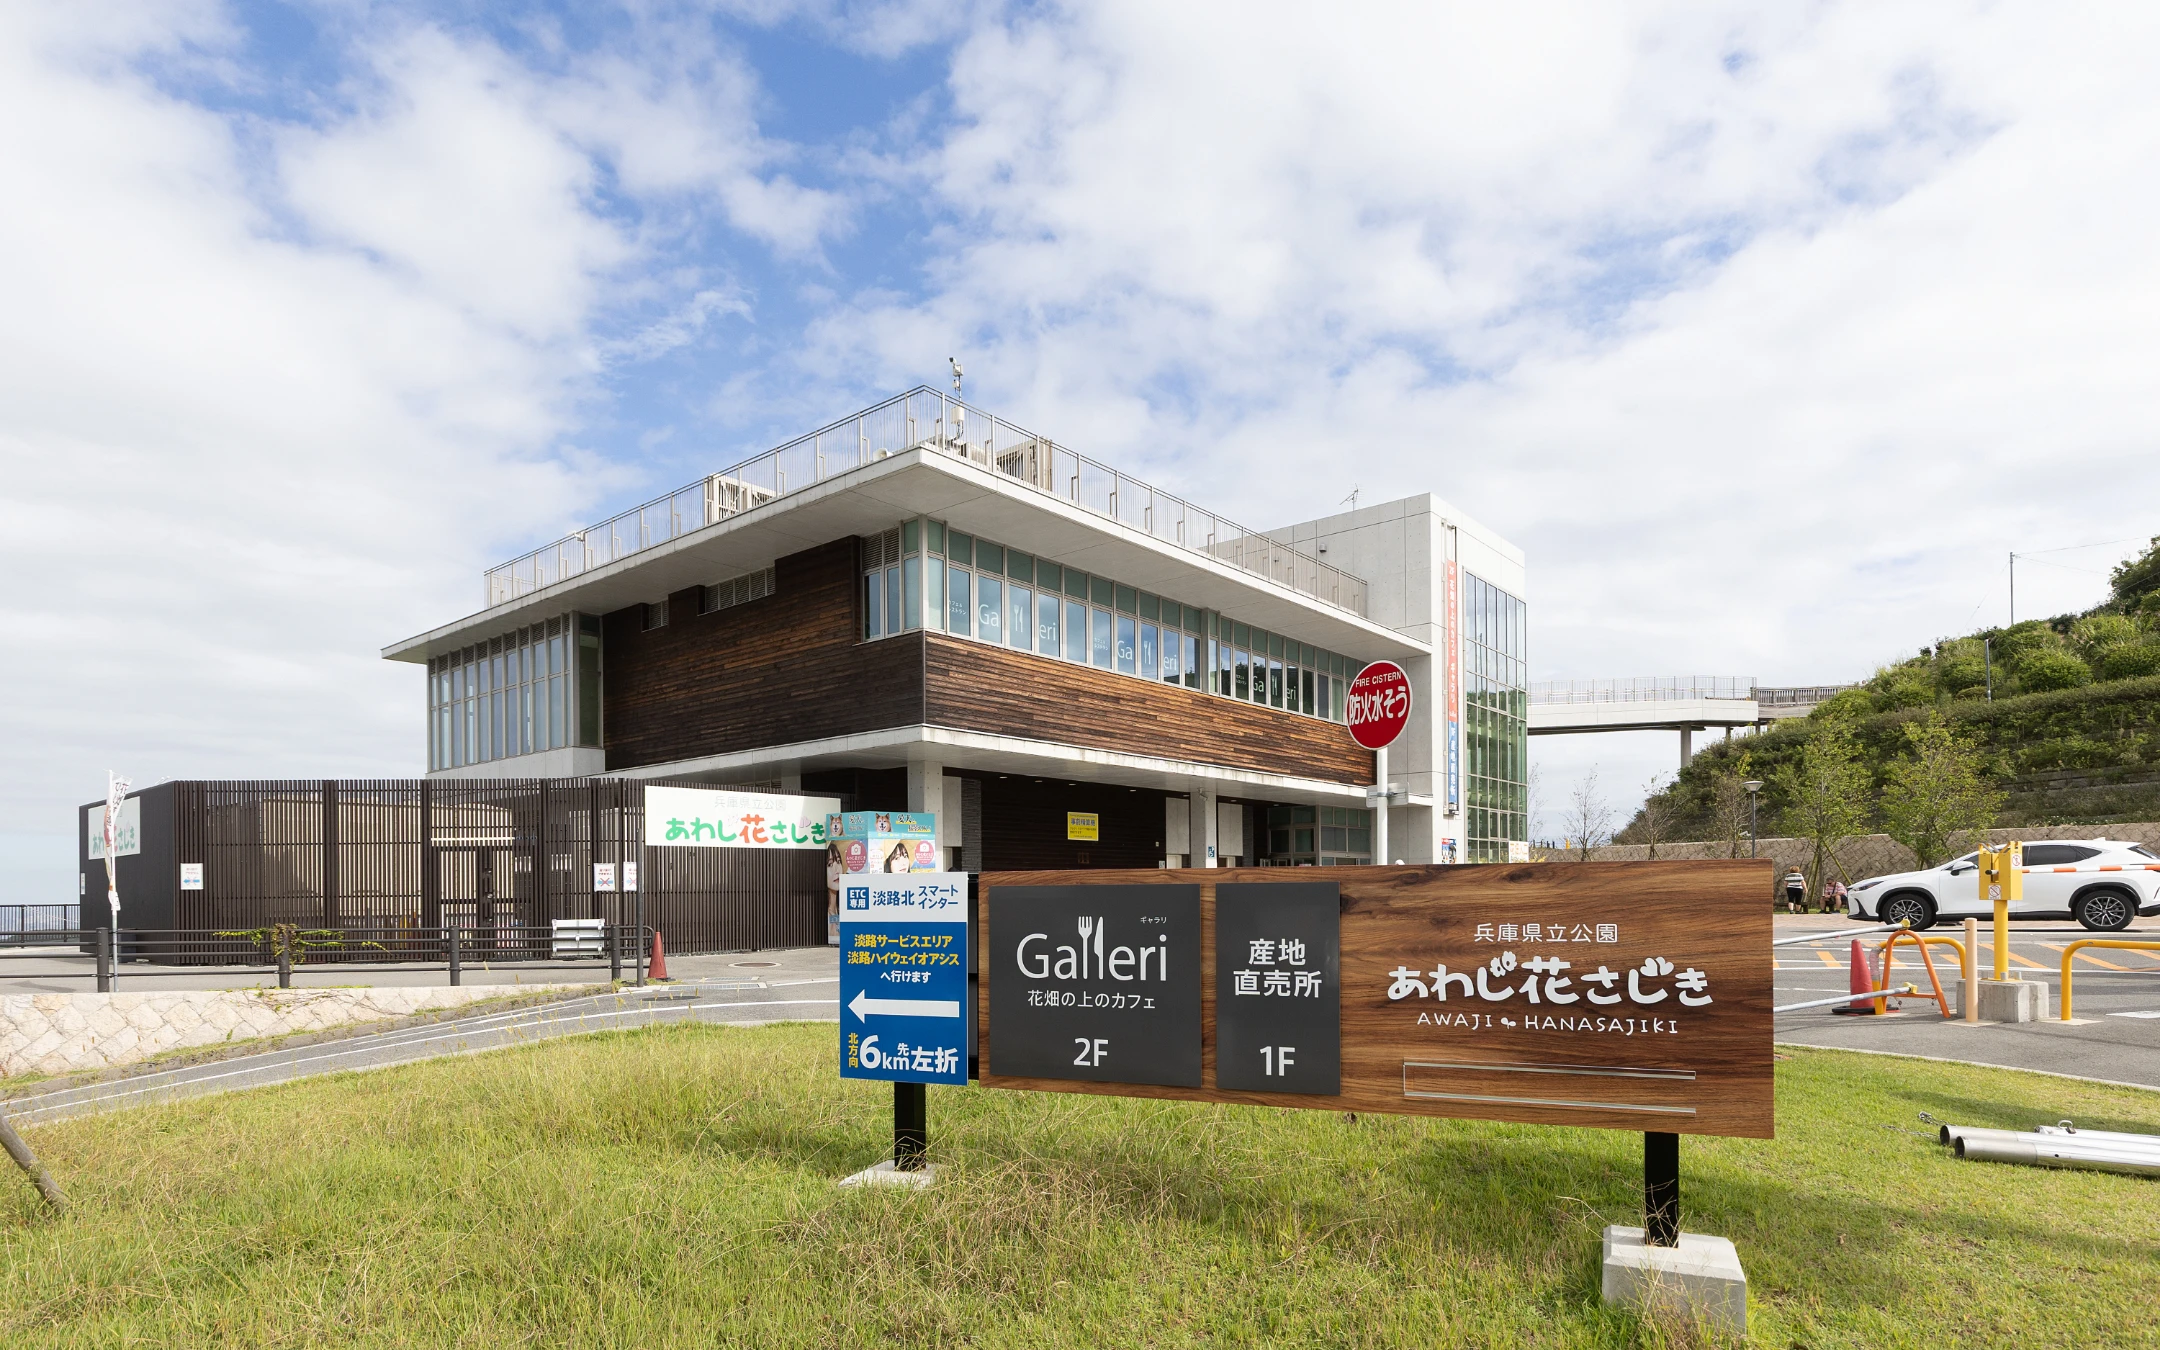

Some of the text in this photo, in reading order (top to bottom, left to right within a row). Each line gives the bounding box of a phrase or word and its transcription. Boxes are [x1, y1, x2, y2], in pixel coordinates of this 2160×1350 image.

[1355, 671, 1402, 688] FIRE CISTERN
[1349, 685, 1408, 726] 防火水そう
[849, 889, 866, 898] ETC
[873, 890, 915, 906] 淡路北
[918, 884, 959, 897] スマート
[849, 899, 866, 908] 専用
[918, 897, 959, 909] インター
[1140, 916, 1167, 924] ギャラリ
[854, 934, 953, 948] 淡路サービスエリア
[1474, 923, 1618, 943] 兵庫県立公園
[847, 951, 960, 965] 淡路ハイウェイオアシス
[1016, 916, 1167, 981] Galleri
[1248, 938, 1306, 966] 産地
[880, 970, 932, 983] へ行けます
[1233, 969, 1323, 998] 直売所
[1387, 951, 1713, 1007] あわじ花さじき
[1027, 989, 1156, 1009] 花畑の上のカフェ
[1417, 1012, 1678, 1036] AWAJI HANASAJIKI
[848, 1033, 859, 1068] 北方向
[1073, 1037, 1109, 1067] 2F
[1259, 1046, 1296, 1076] 1F
